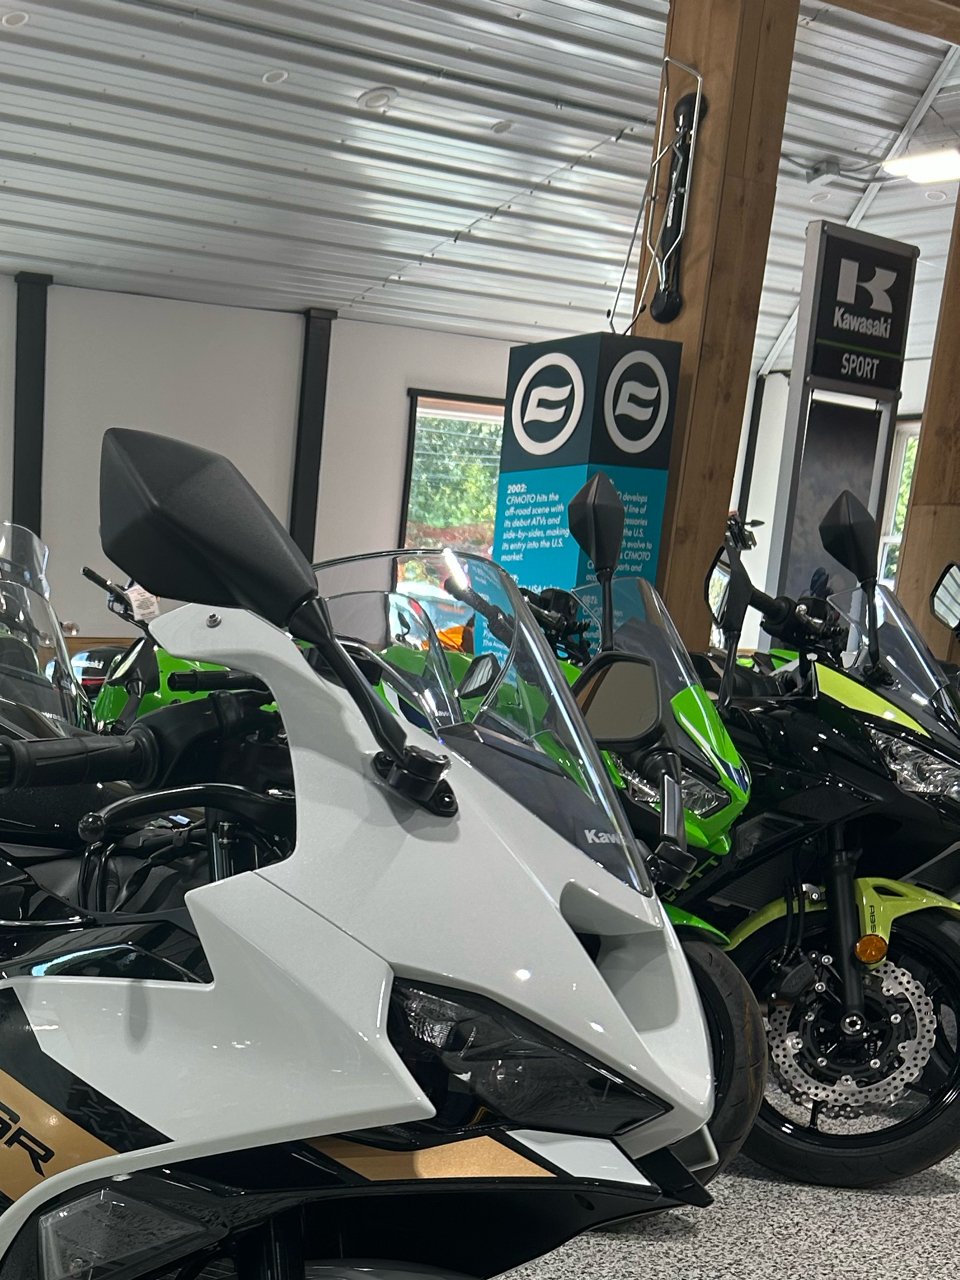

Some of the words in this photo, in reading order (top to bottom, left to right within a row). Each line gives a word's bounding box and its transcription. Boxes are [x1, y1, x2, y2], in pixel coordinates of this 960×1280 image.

[833, 306, 891, 338] Kawasaki
[841, 353, 879, 379] SPORT
[506, 494, 536, 505] CFMOTO
[537, 493, 548, 502] hits
[549, 492, 560, 501] the
[622, 491, 648, 504] develops
[505, 505, 532, 517] off-road
[532, 507, 550, 515] scene
[551, 503, 565, 513] with
[629, 505, 640, 514] line
[640, 505, 647, 514] of
[512, 518, 531, 528] debut
[531, 516, 547, 526] ATVs
[547, 515, 561, 525] and
[546, 526, 570, 538] making
[633, 528, 645, 537] U.S.
[502, 542, 510, 550] its
[510, 541, 527, 552] entry
[527, 540, 540, 549] into
[540, 539, 551, 548] the
[551, 538, 564, 548] U.S.
[627, 540, 645, 549] evolve
[646, 541, 652, 550] to
[623, 551, 651, 561] CFMOTO
[631, 563, 643, 572] and
[869, 904, 877, 934] ABS
